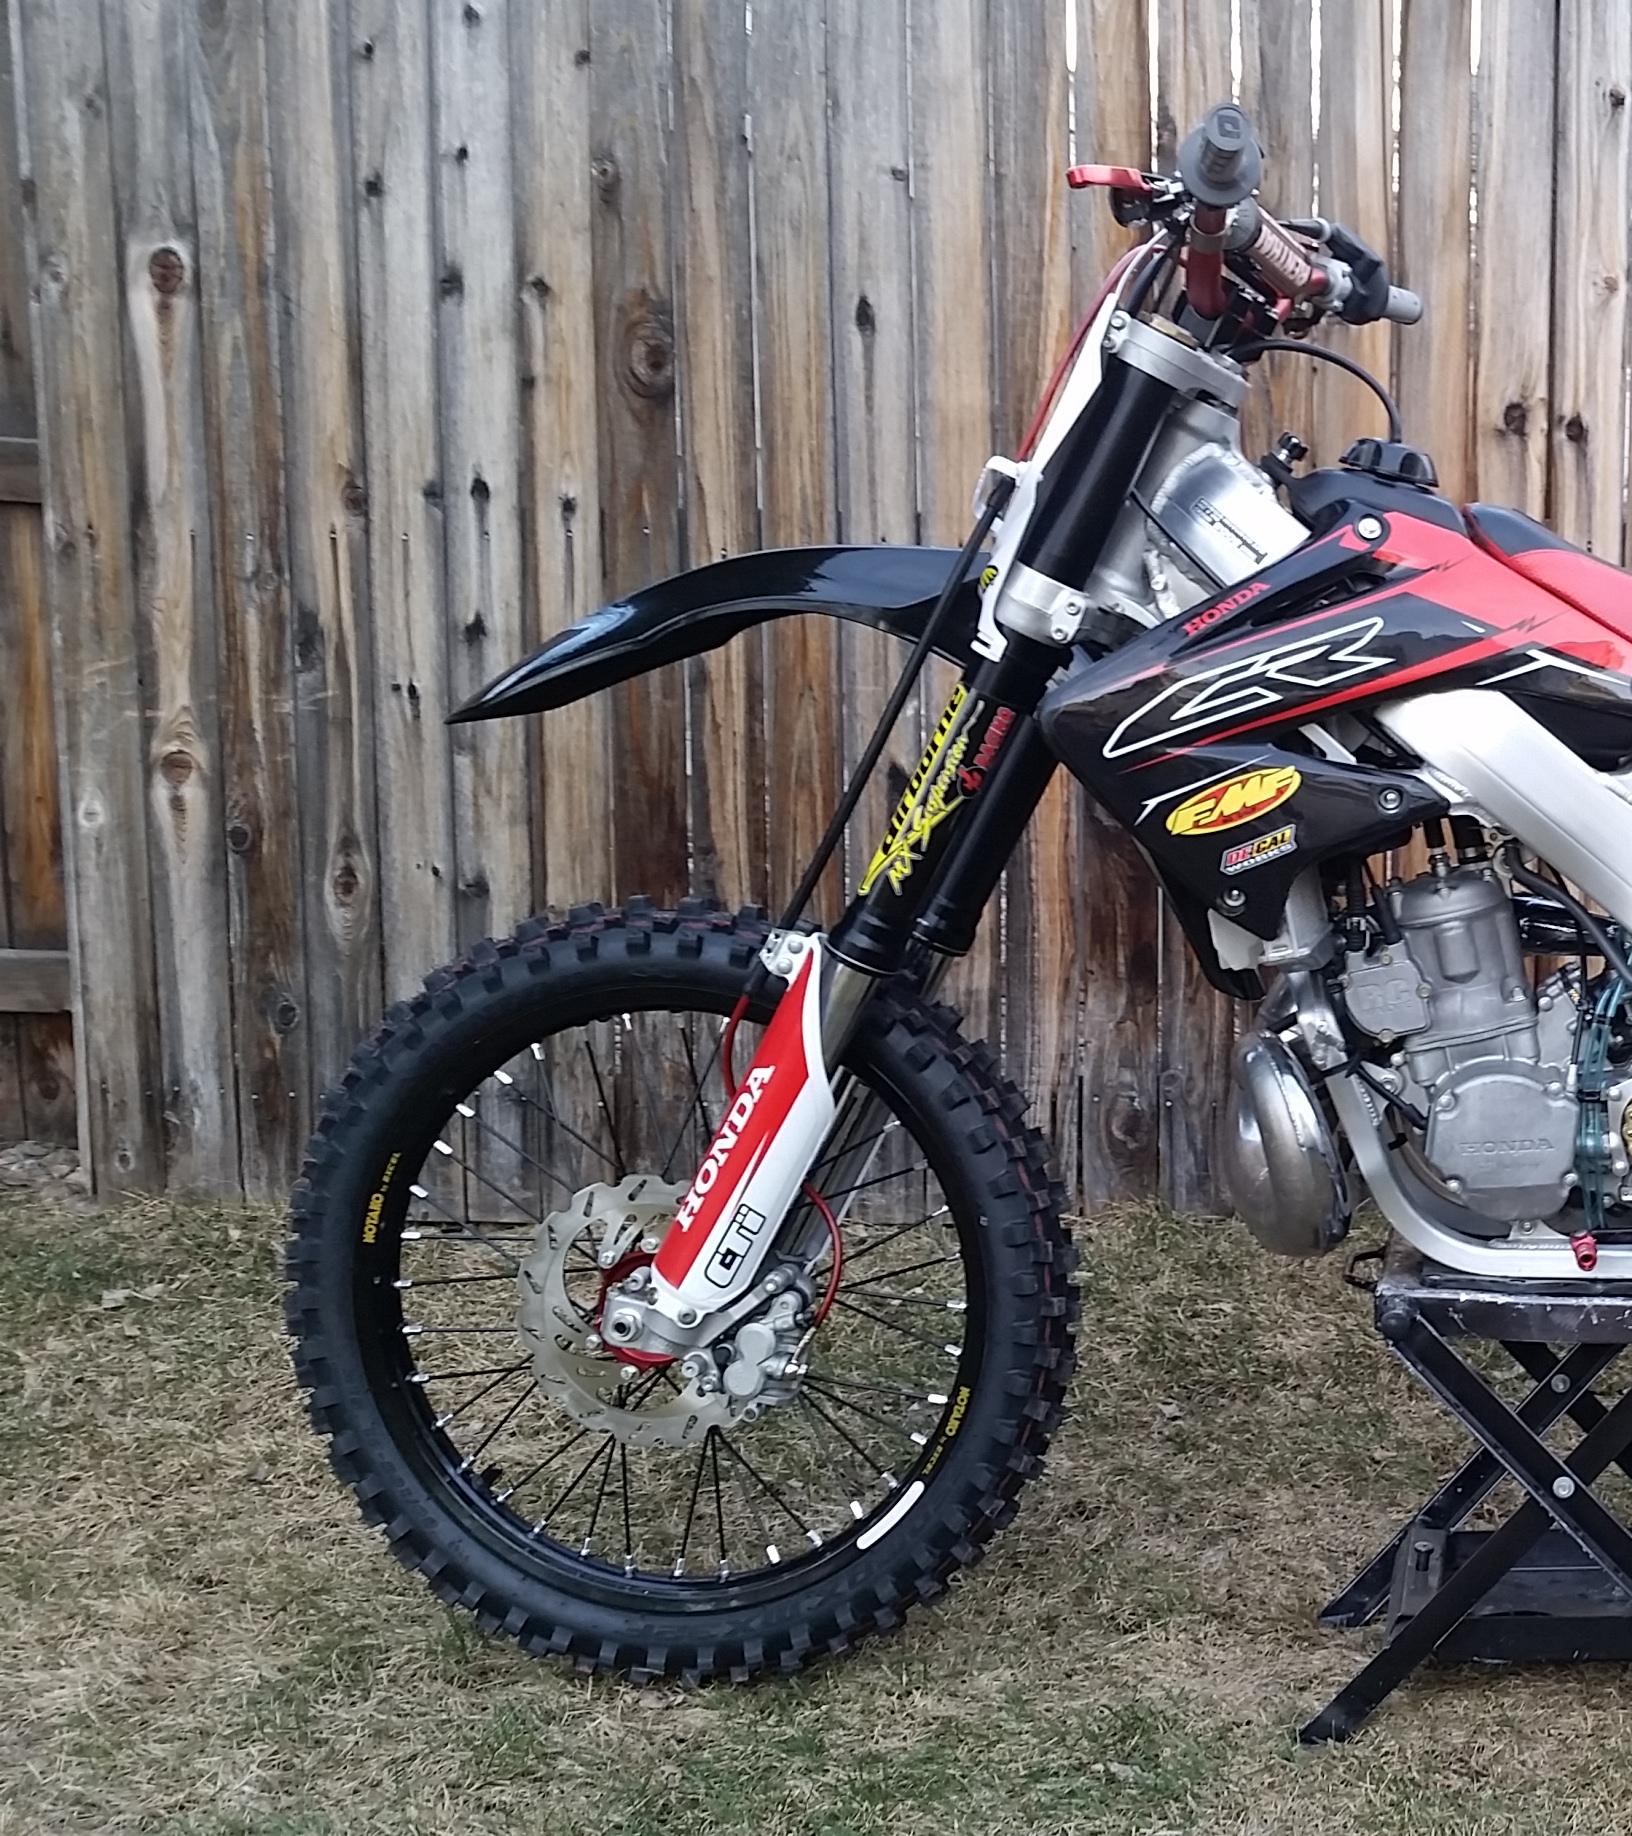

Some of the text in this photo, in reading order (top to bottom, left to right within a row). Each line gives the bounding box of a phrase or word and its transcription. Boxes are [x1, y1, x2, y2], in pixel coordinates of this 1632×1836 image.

[1182, 581, 1272, 637] HONDA
[1102, 616, 1397, 759] CR
[1170, 765, 1296, 836] FMF
[1225, 843, 1293, 872] WORKS
[1226, 831, 1292, 866] DECAL
[675, 1065, 776, 1233] HONDA
[1460, 1138, 1554, 1156] HONDA
